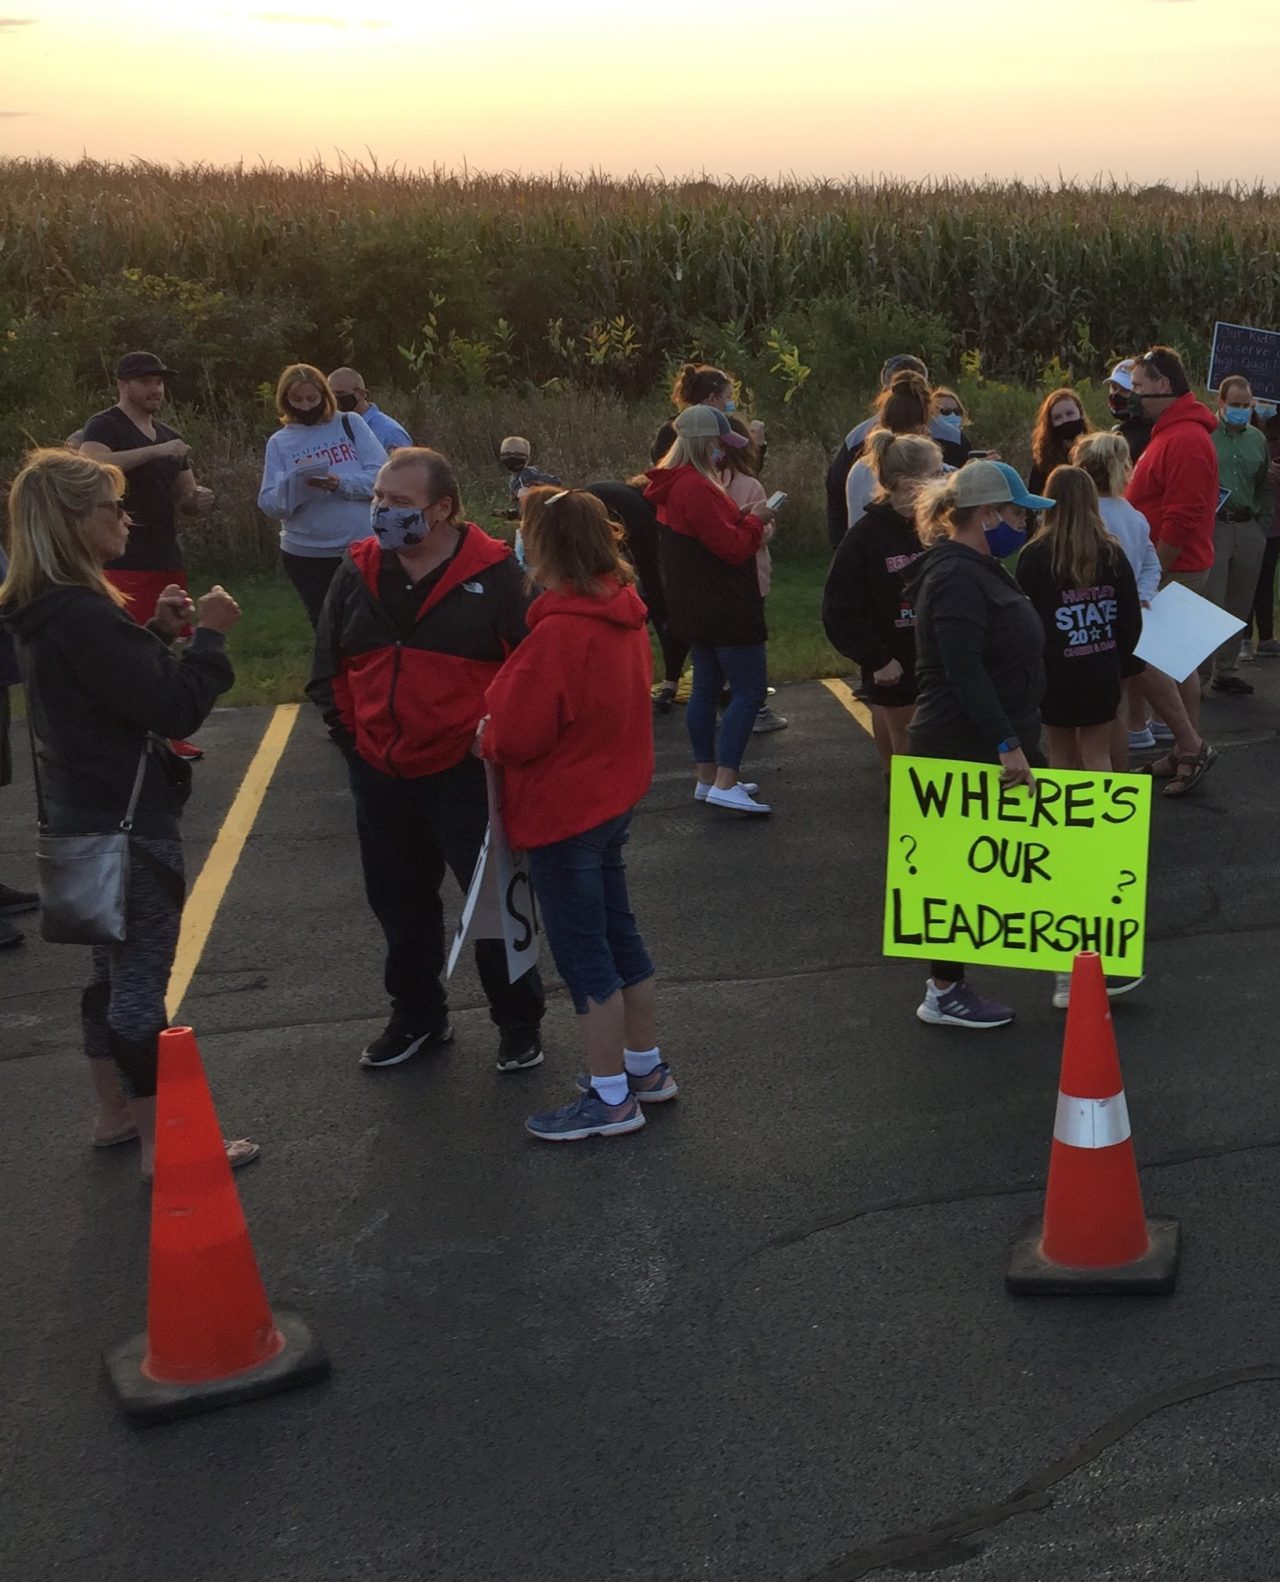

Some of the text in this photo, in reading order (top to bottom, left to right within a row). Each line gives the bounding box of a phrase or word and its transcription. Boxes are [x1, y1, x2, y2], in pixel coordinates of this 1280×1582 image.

[1055, 599, 1118, 631] STATE
[908, 767, 1139, 828] WHERE'S
[967, 835, 1052, 883] OUR
[892, 888, 1139, 958] LEADERSHIP
